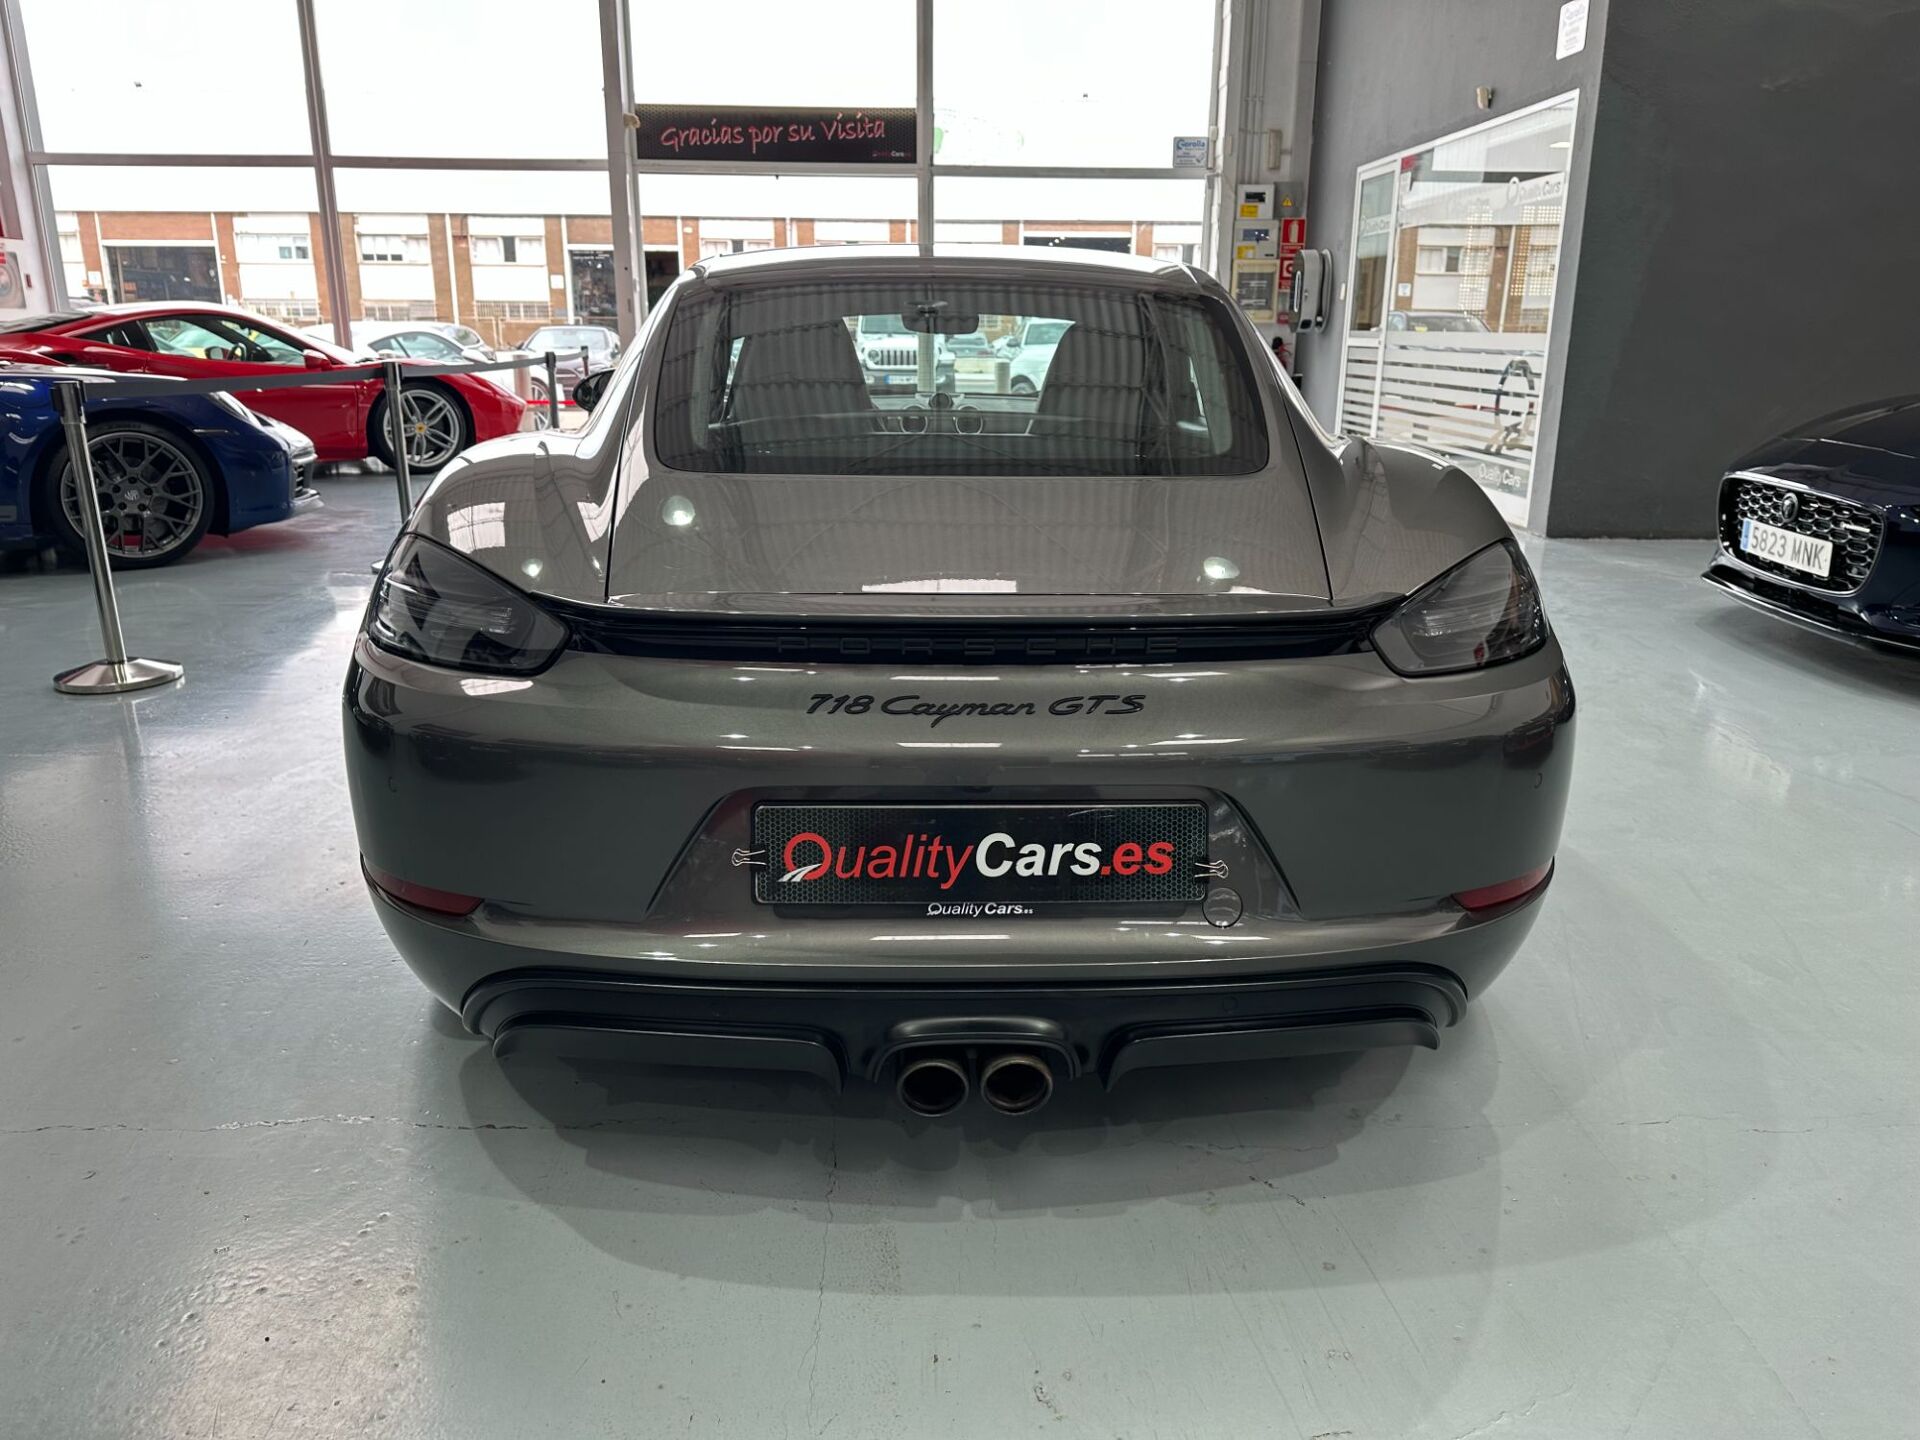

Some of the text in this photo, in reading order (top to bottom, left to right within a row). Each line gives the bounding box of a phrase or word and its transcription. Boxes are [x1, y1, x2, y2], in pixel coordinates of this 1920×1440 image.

[660, 117, 745, 151] Gracias
[749, 124, 782, 154] por
[788, 123, 815, 143] su
[1751, 526, 1826, 570] 5823 MNK
[777, 636, 1180, 656] PORSCHE
[805, 693, 1147, 728] 718 Cayman GTS
[777, 831, 1176, 890] QualityCars.es
